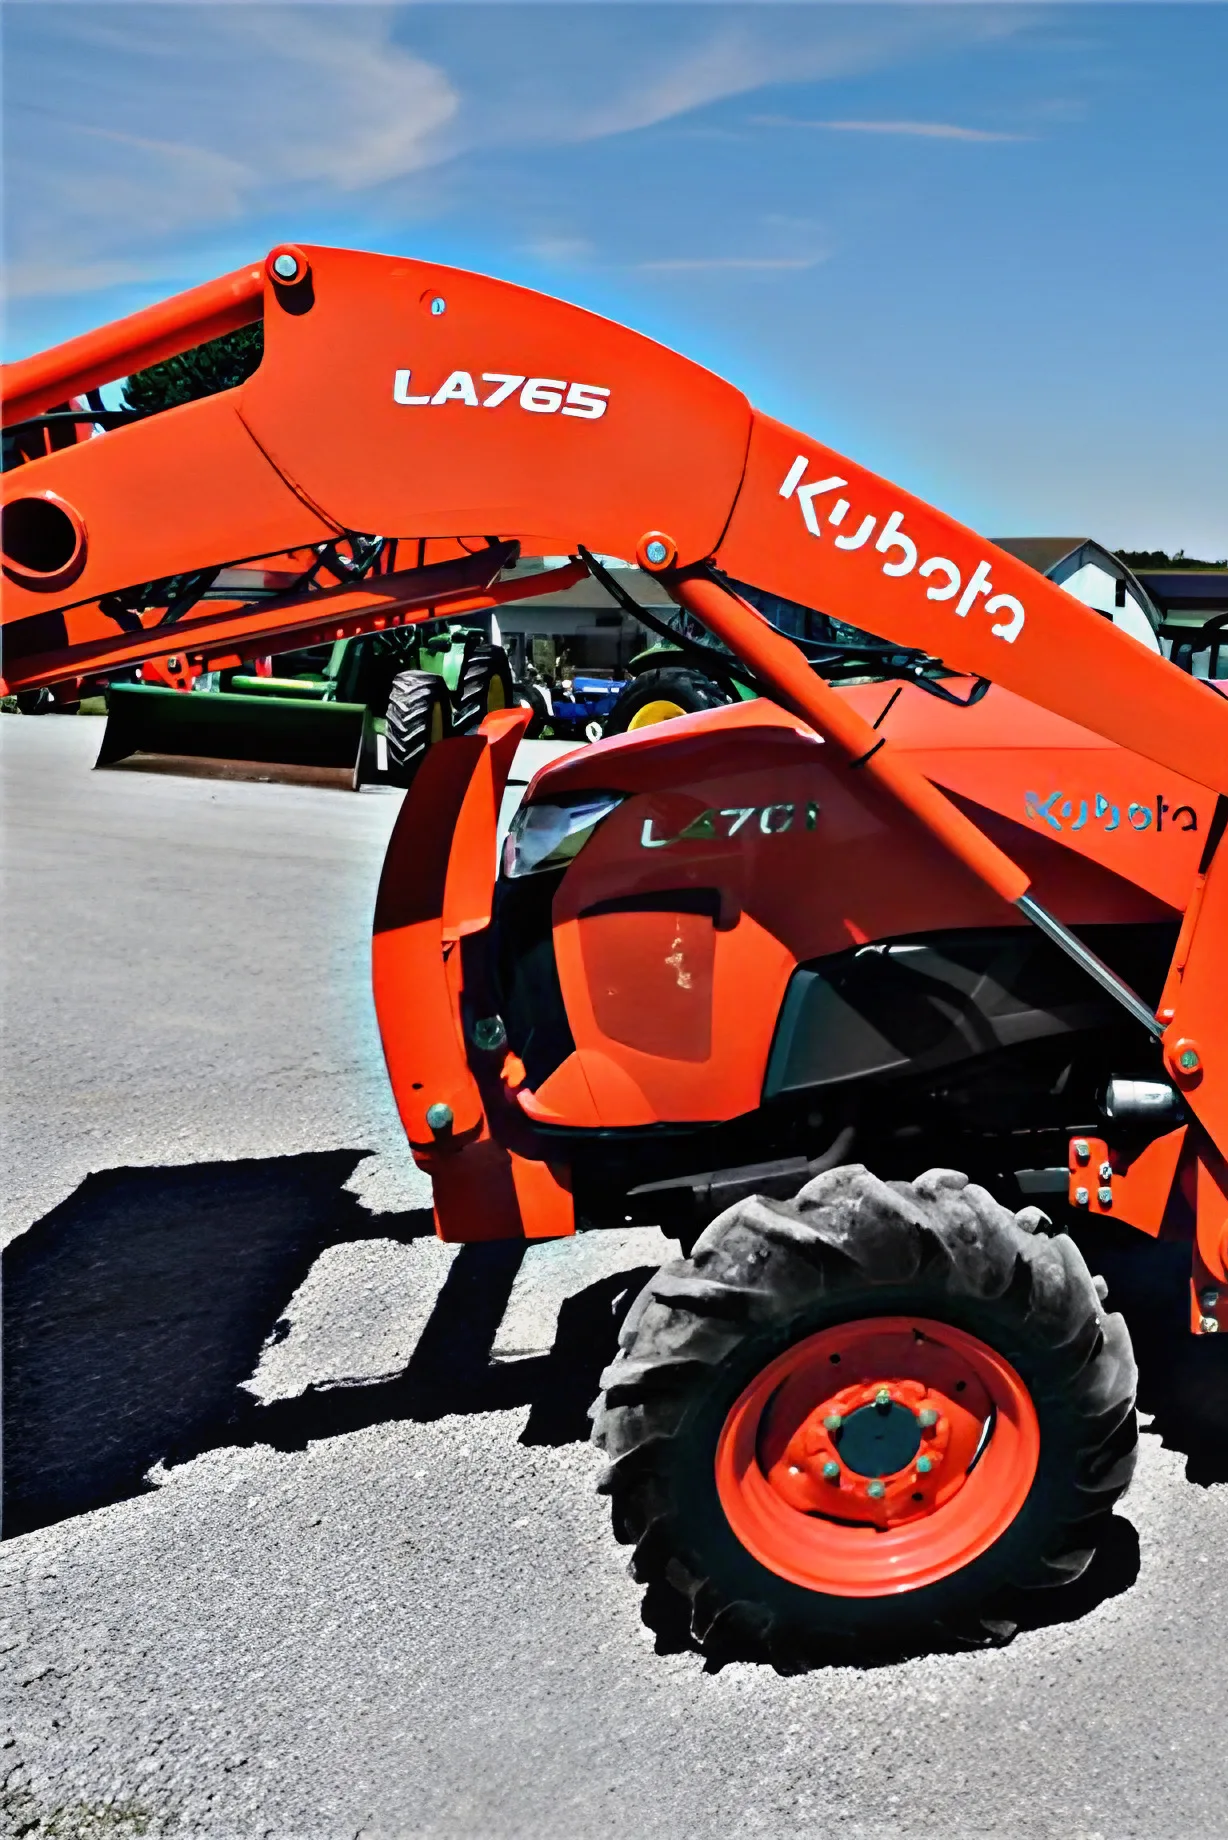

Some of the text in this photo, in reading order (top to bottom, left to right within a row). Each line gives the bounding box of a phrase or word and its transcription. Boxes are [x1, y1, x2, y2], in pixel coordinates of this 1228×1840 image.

[393, 369, 611, 419] LA765
[778, 455, 1025, 643] Kubota
[1024, 791, 1198, 832] Kubota
